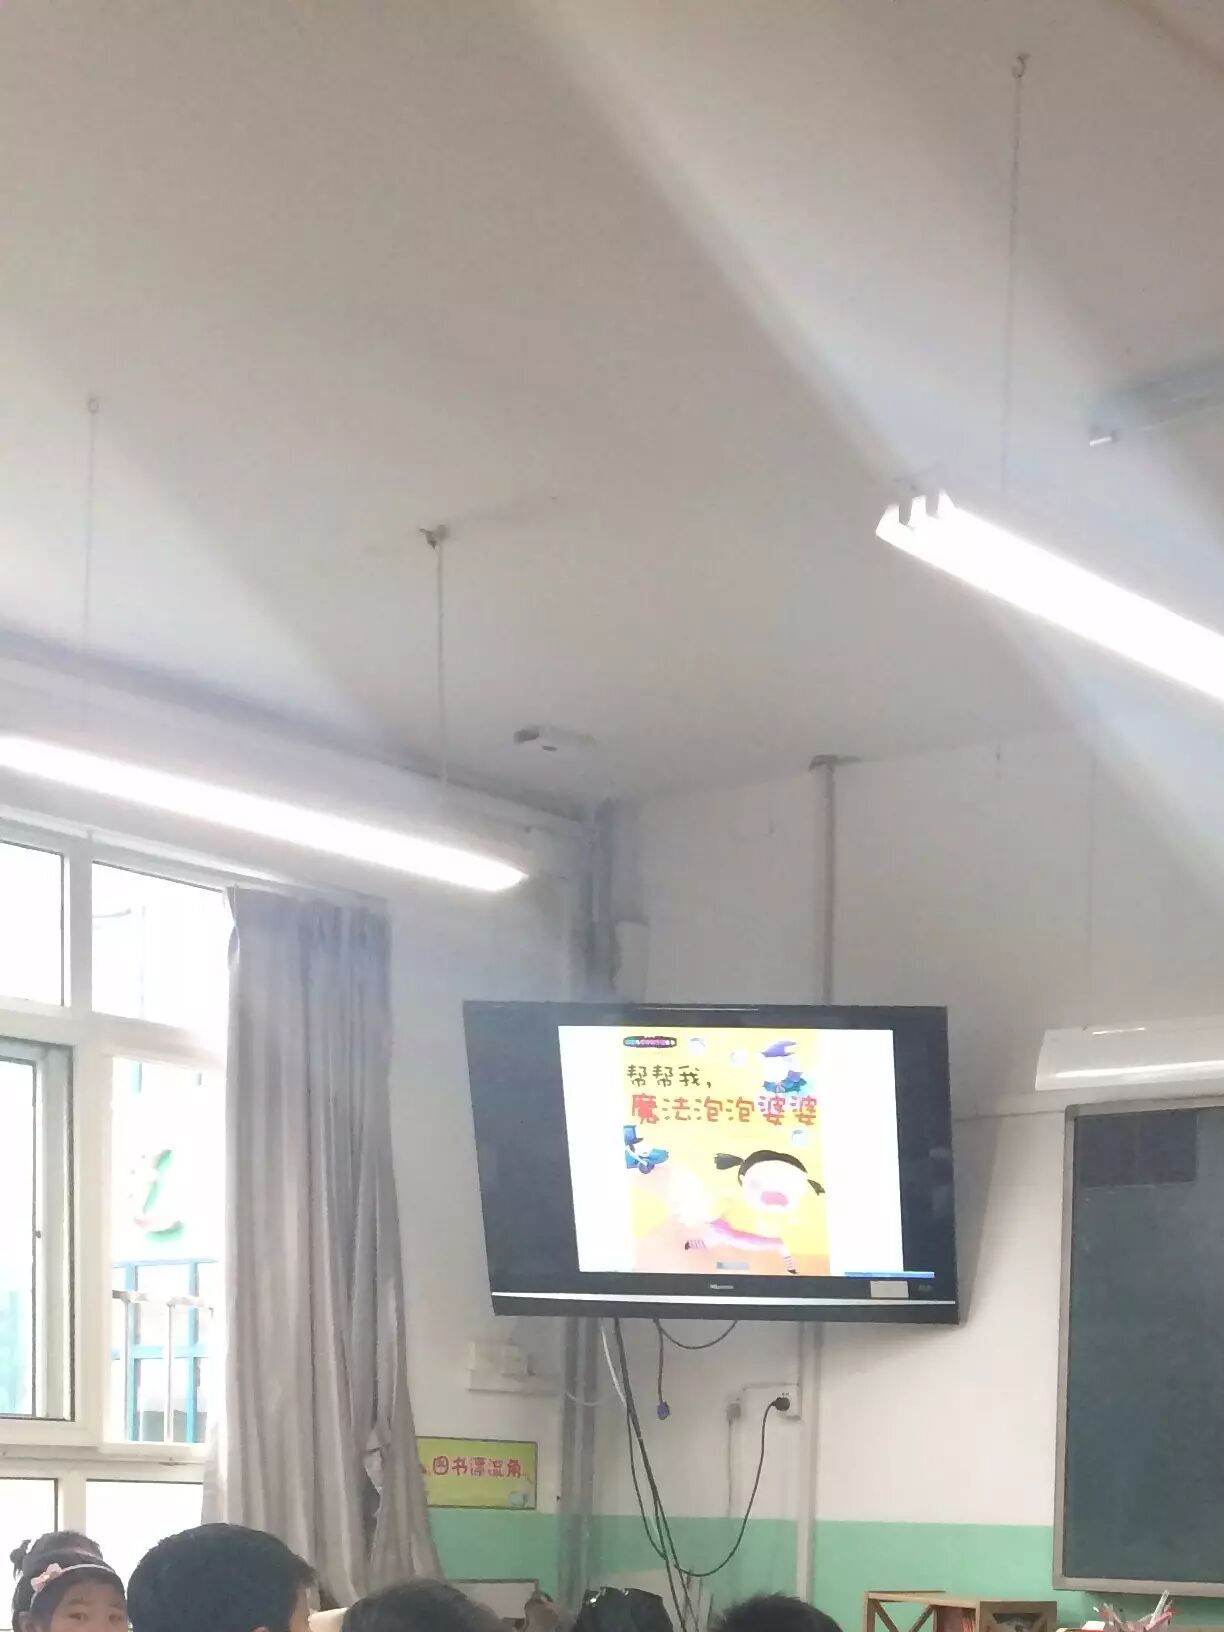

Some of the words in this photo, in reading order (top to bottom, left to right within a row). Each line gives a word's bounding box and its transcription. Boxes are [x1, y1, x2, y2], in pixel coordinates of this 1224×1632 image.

[631, 1093, 818, 1126] 魔法泡泡婆婆
